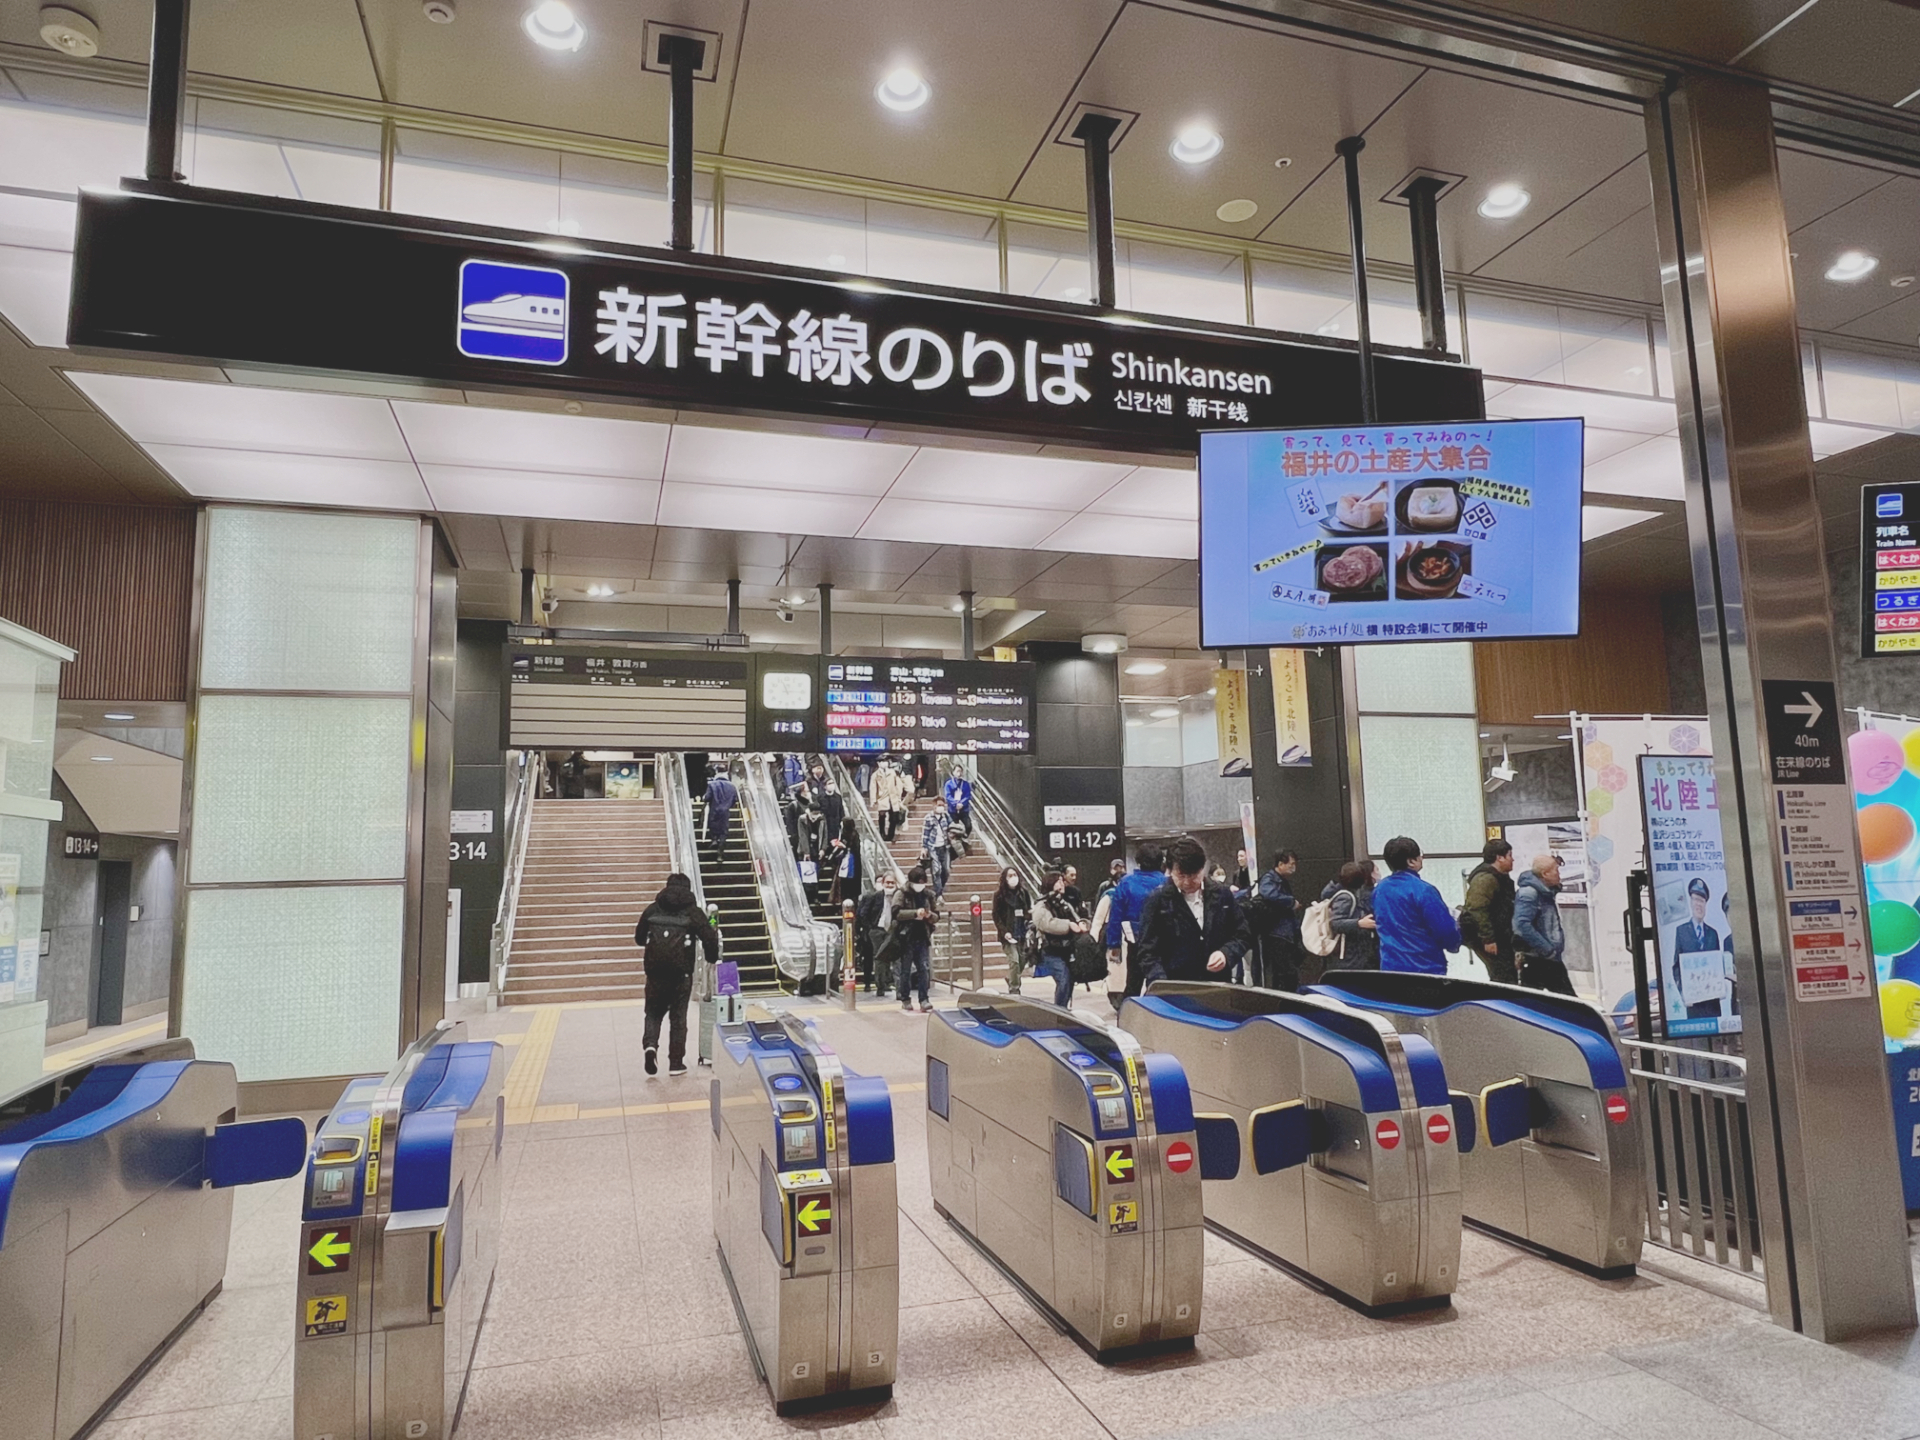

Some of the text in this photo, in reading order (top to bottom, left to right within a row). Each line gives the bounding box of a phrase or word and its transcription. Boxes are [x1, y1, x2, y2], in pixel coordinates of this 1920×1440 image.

[594, 286, 1093, 406] 新幹線のりば
[1111, 351, 1272, 395] Shinkansen
[1113, 389, 1173, 416] 신칸센
[1187, 396, 1249, 423] 新干线
[1281, 444, 1492, 477] 福井の土産大集合
[1876, 525, 1909, 538] 列車名
[1876, 538, 1917, 547] Train Name
[1879, 553, 1919, 565] はくたか
[1879, 575, 1918, 586] かがやき
[1879, 595, 1919, 607] つるぎ
[1877, 616, 1919, 628] はくたか
[1382, 621, 1488, 636] 特設会場にて開催中
[1878, 637, 1917, 648] かがやき
[533, 655, 565, 666] 新幹線
[920, 693, 953, 706] Toyama
[1283, 660, 1297, 741] ようこそ北陸へ
[890, 715, 916, 728] 11:59
[1226, 679, 1239, 754] ようこそ北陸へ
[890, 738, 915, 750] 12:31
[920, 738, 953, 751] Toyama
[1794, 734, 1819, 747] 40m
[1776, 756, 1831, 769] 在来線のりば
[1777, 769, 1800, 778] JR Line
[1386, 1274, 1394, 1283] 4
[1179, 1307, 1187, 1316] 4
[1116, 1316, 1125, 1326] 3
[870, 1353, 880, 1365] 3
[796, 1365, 806, 1376] 2
[410, 1423, 422, 1434] 2
